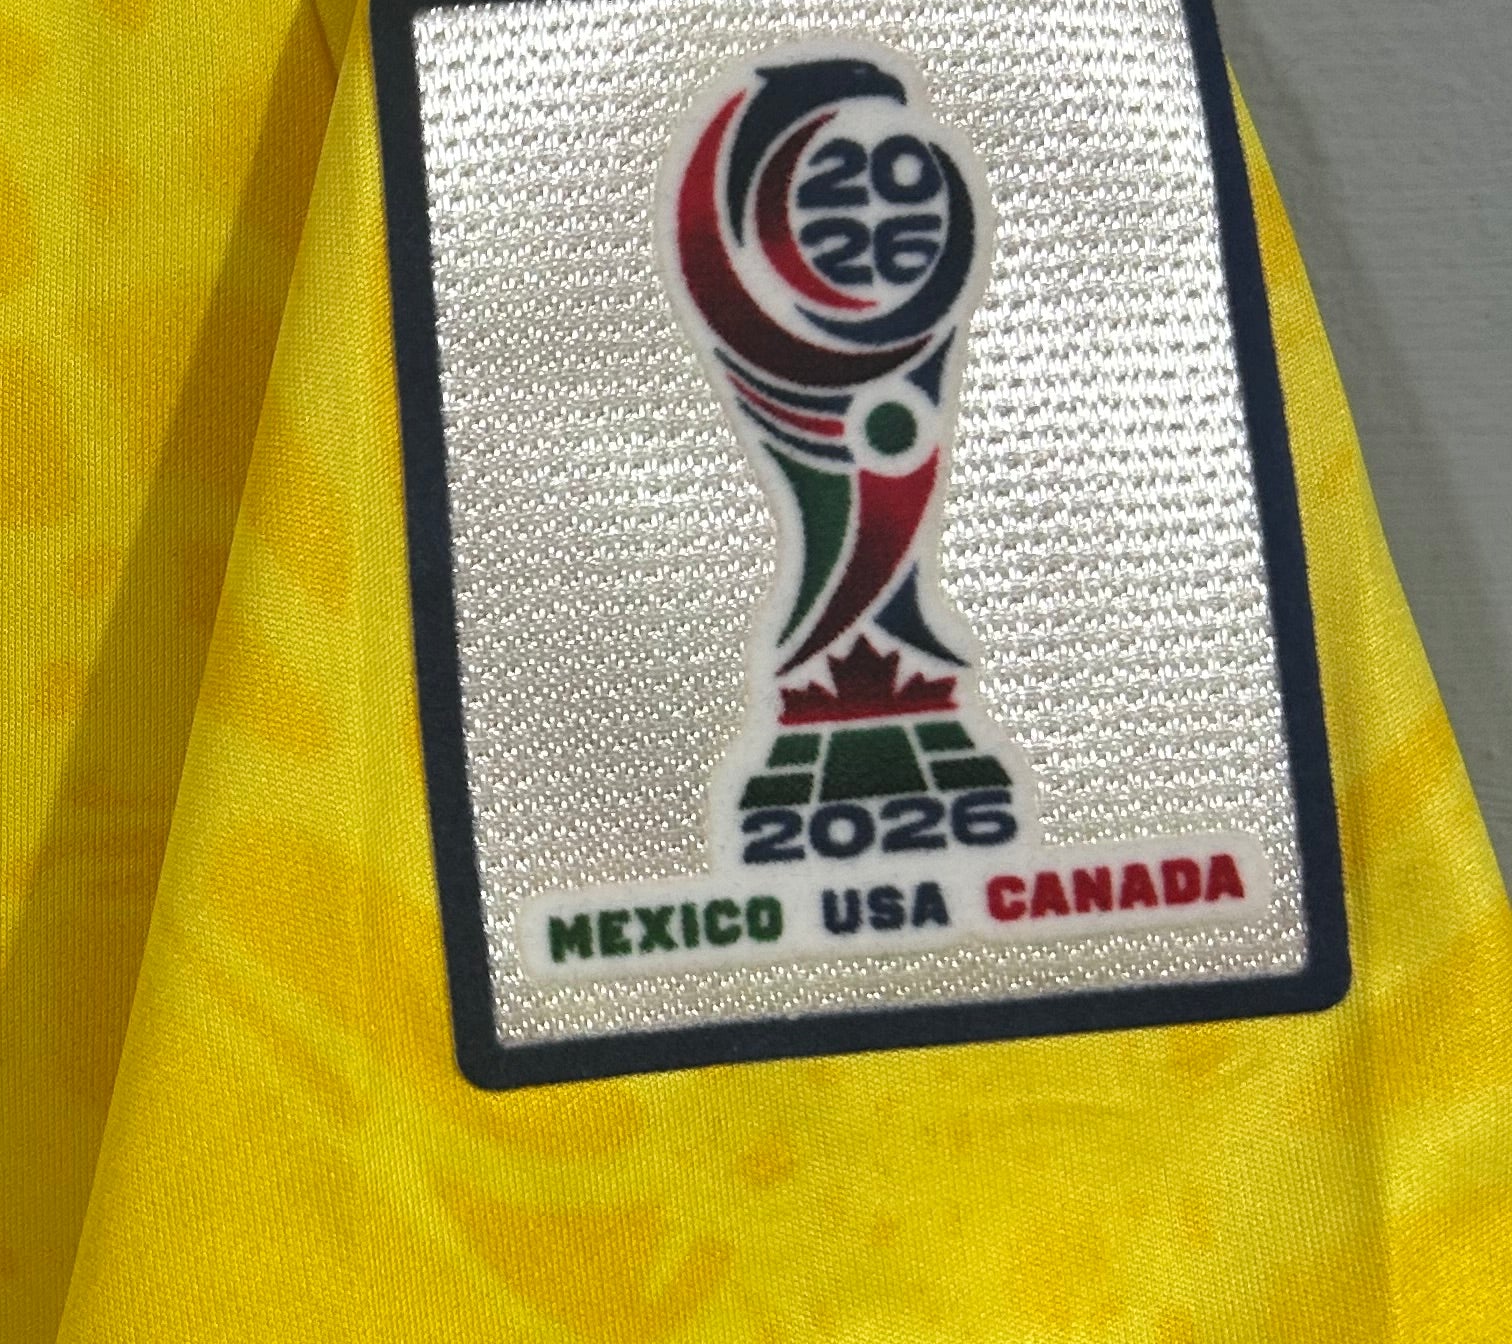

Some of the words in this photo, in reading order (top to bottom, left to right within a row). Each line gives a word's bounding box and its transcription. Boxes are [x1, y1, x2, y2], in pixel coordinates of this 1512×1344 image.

[796, 133, 944, 210] 20
[798, 213, 943, 288] 26
[740, 790, 1018, 865] 2026
[547, 895, 784, 964] MEXICO
[821, 882, 950, 937] USA
[986, 854, 1246, 924] CANADA
